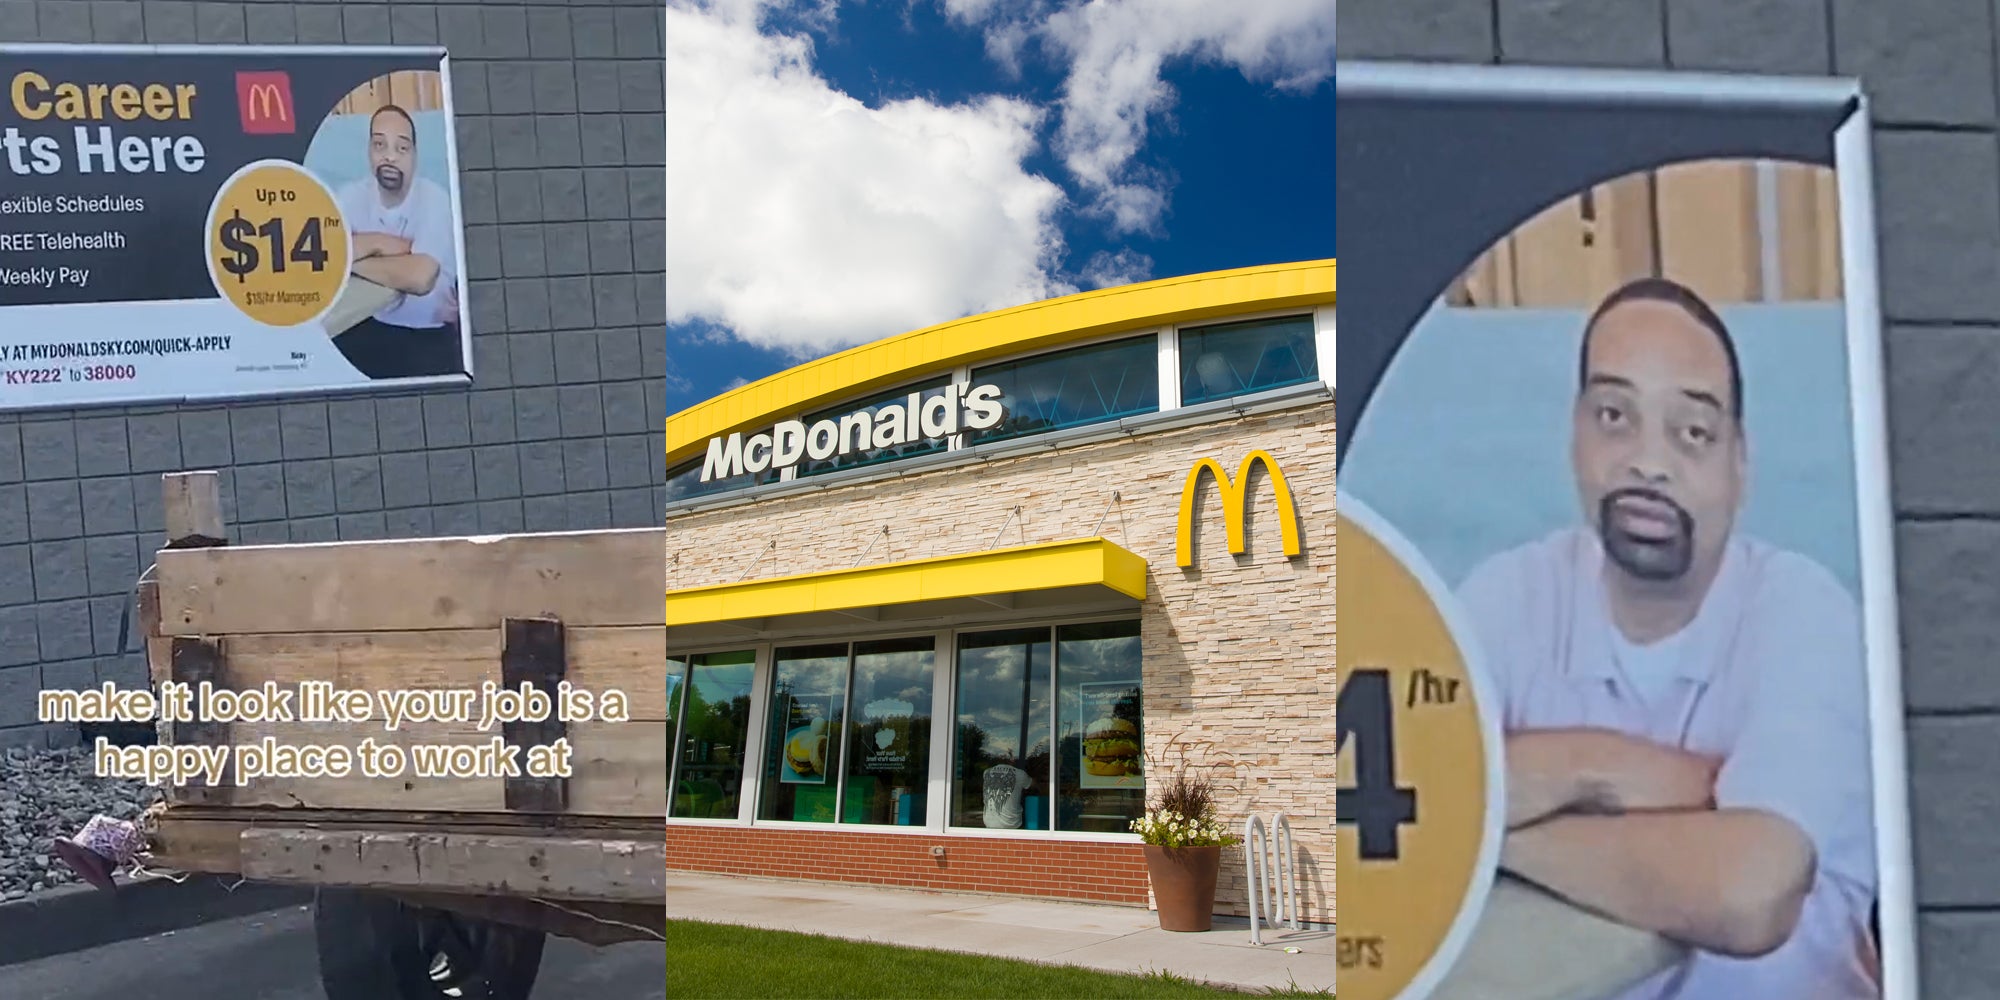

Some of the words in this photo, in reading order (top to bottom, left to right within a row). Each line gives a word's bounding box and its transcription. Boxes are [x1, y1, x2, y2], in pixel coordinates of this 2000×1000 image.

[11, 71, 197, 121] Career
[0, 127, 61, 175] ts
[74, 126, 205, 173] Here
[0, 196, 52, 214] exible
[56, 195, 144, 213] Schedules
[256, 189, 276, 206] Up
[281, 189, 296, 202] to
[37, 231, 126, 250] Telehealth
[220, 209, 328, 283] $14
[59, 267, 89, 287] Pay
[13, 345, 28, 360] AT
[31, 335, 232, 360] MYDONALDSKY.COM/QUICK-APPLY
[70, 368, 81, 382] to
[84, 365, 136, 382] 38000
[700, 381, 1006, 483] McDonald's
[1407, 668, 1460, 709] /hr
